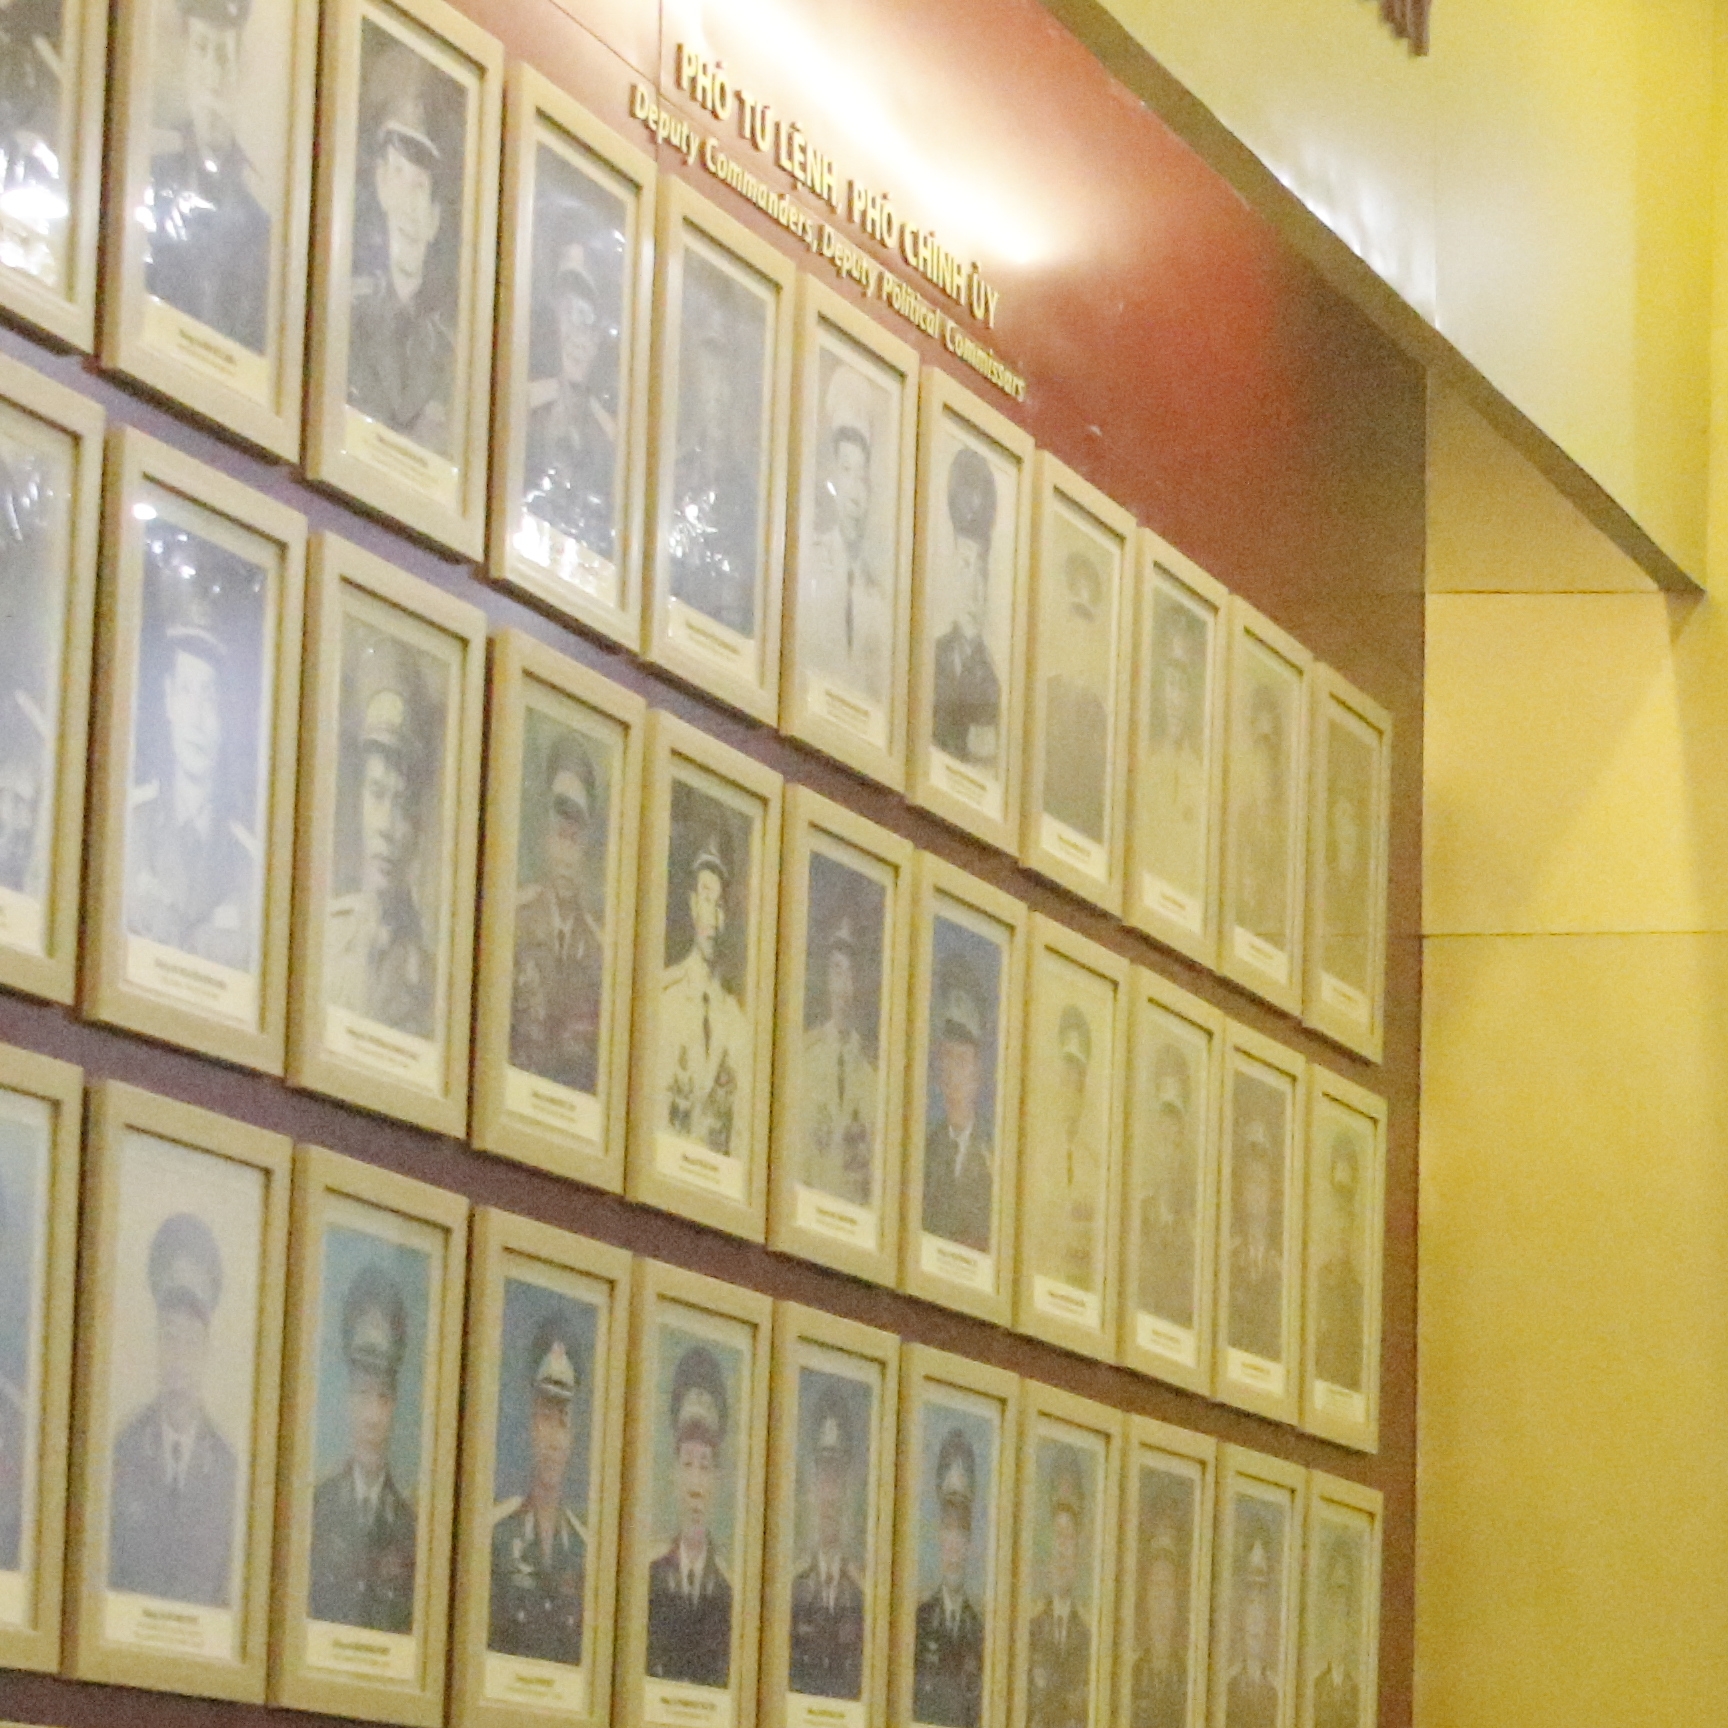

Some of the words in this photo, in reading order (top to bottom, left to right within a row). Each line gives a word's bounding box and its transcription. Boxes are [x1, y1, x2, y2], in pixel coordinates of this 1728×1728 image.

[630, 84, 699, 166] Deputy
[702, 137, 818, 253] Commanders,
[820, 224, 877, 298] Deputy
[880, 270, 940, 339] Political
[945, 319, 1026, 402] Commissars
[678, 43, 733, 121] PHÓ
[849, 179, 897, 248] PHÓ
[902, 221, 966, 307] CHÍNH
